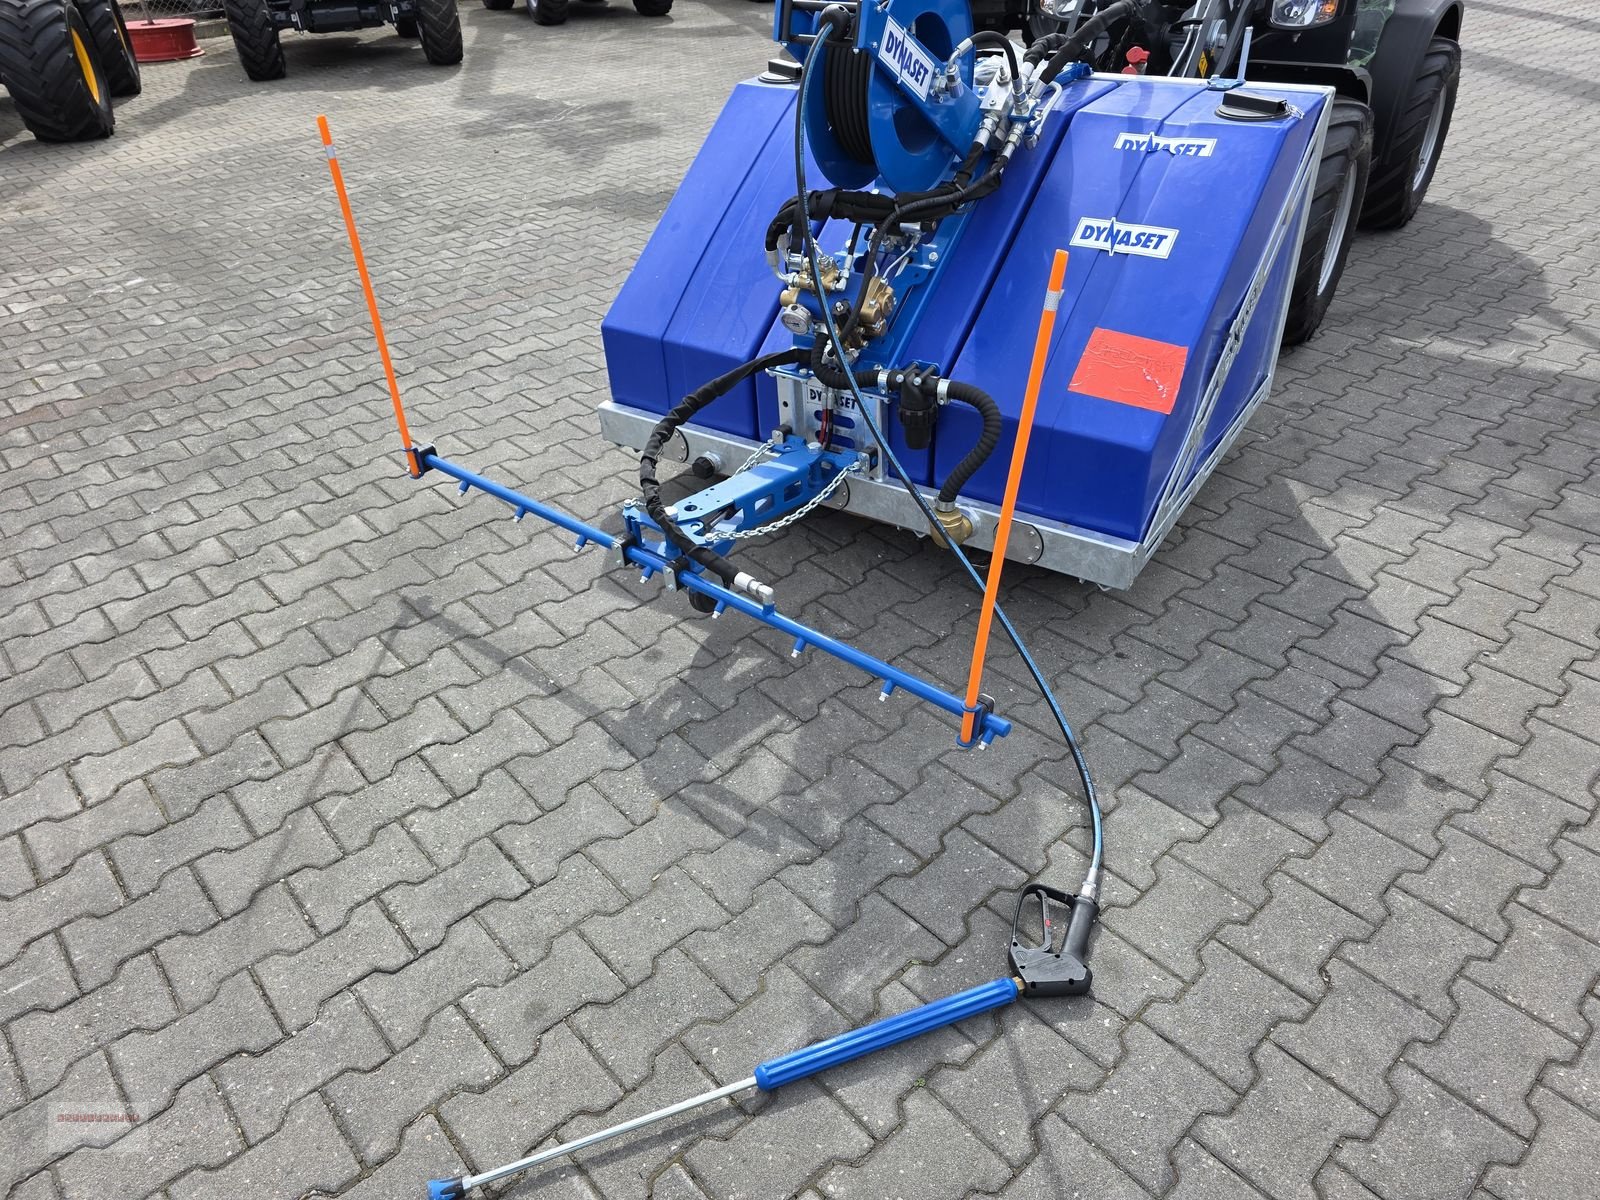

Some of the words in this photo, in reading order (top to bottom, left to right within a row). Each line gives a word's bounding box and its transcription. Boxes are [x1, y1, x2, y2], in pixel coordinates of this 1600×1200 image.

[885, 29, 929, 87] DYNASET
[1080, 219, 1168, 253] DYNASET
[809, 388, 857, 410] DYSET
